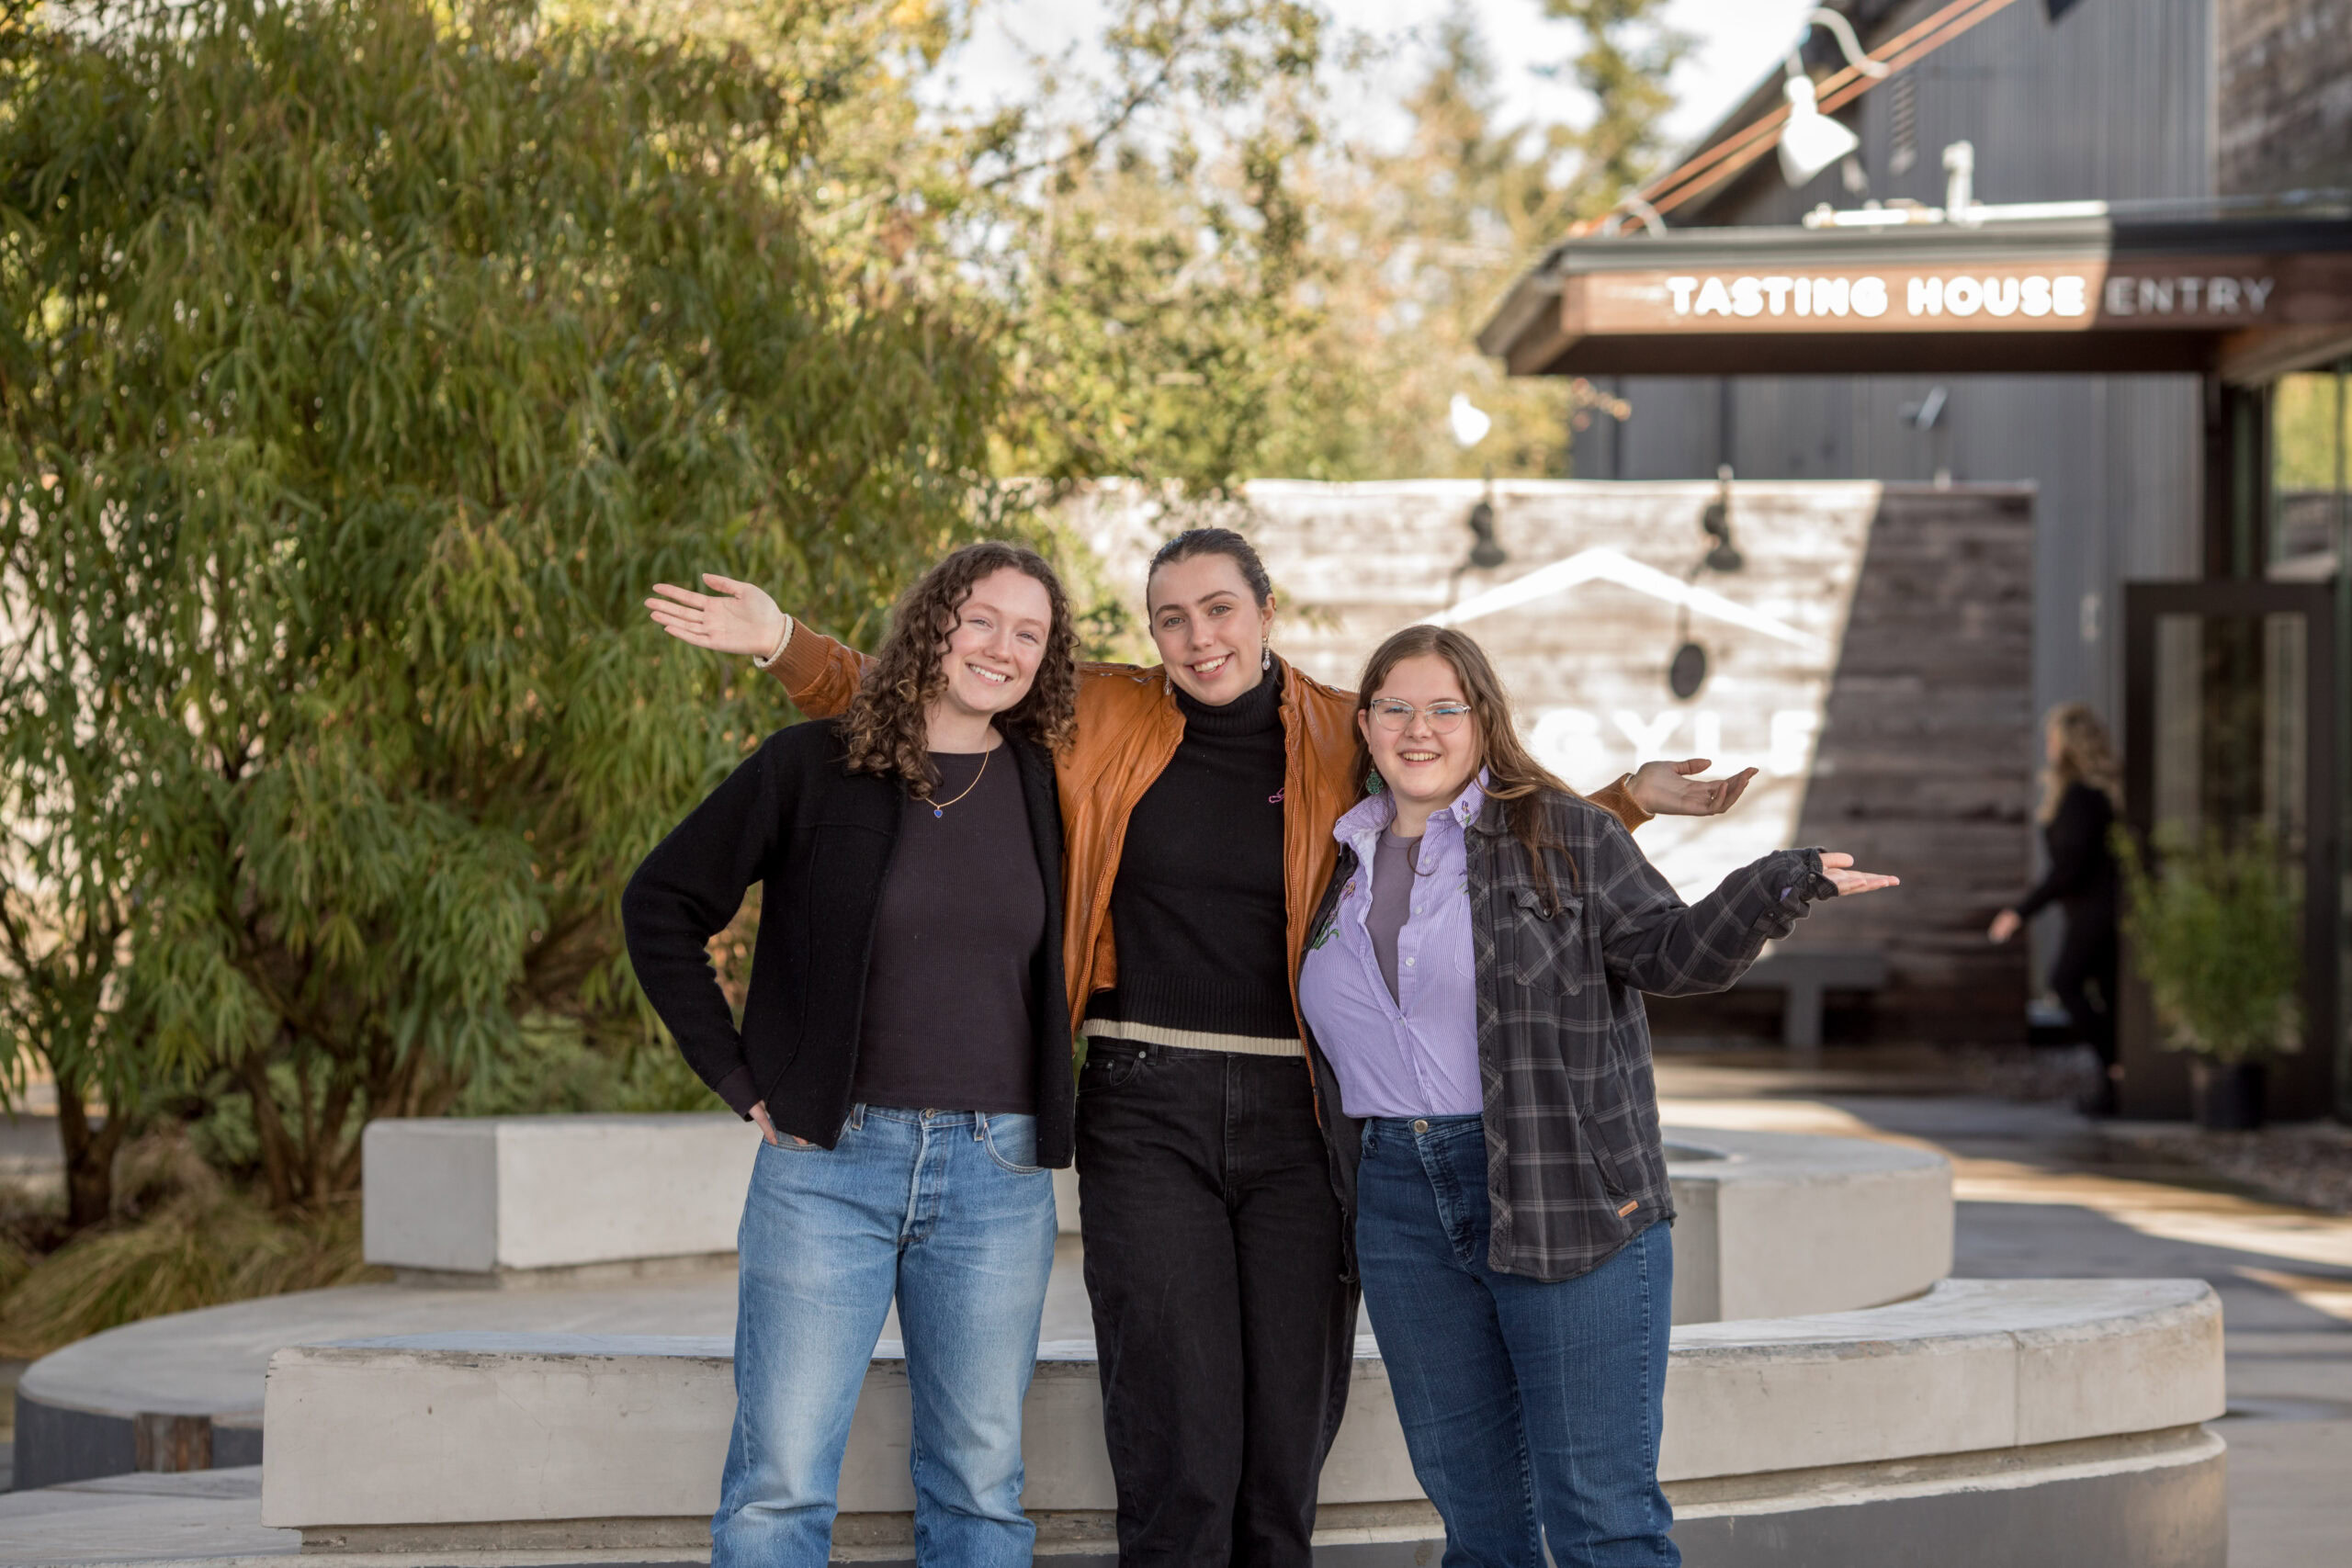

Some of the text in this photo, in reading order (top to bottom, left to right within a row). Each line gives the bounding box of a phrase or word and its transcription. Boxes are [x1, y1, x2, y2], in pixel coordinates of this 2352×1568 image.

[1666, 275, 2276, 318] TASTING HOUSE ENTRY
